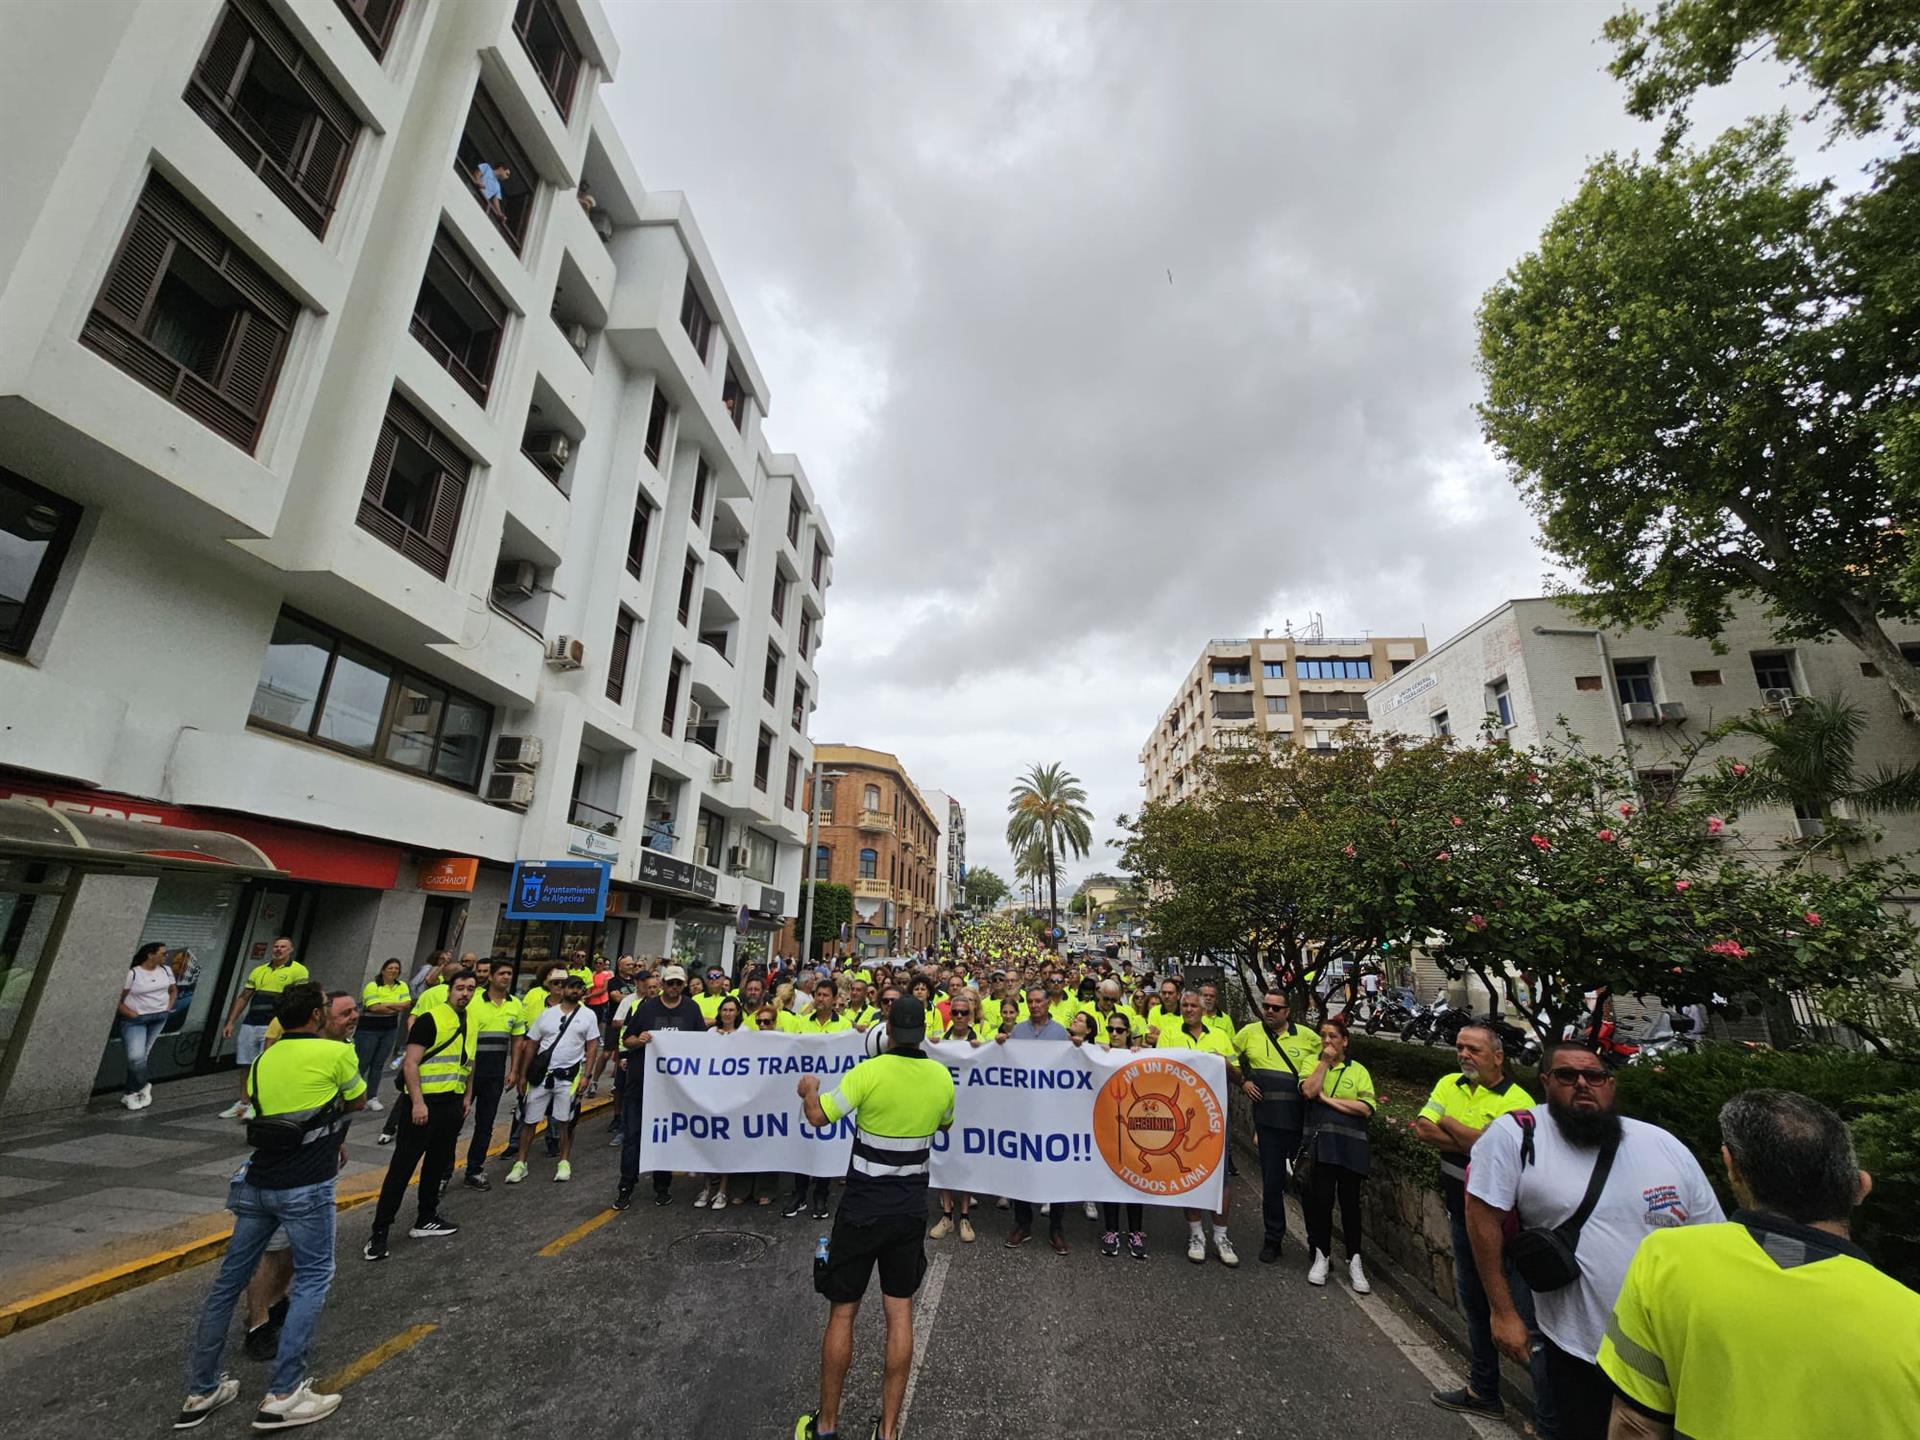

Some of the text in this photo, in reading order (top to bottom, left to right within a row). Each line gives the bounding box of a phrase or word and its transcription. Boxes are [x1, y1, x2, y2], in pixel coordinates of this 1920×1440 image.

[543, 885, 596, 895] Ayuntamiento
[551, 894, 585, 904] Algeciras
[656, 1056, 700, 1075] CON
[708, 1057, 750, 1076] LOS
[757, 1055, 870, 1075] TRABAJA
[967, 1066, 1093, 1090] ACERINOX
[1142, 1061, 1162, 1074] UN
[1164, 1064, 1198, 1087] PASO
[743, 1112, 788, 1139] UN
[963, 1127, 1092, 1162] DIGNO!!
[1169, 1180, 1179, 1192] A
[1180, 1163, 1209, 1188] UNA!
